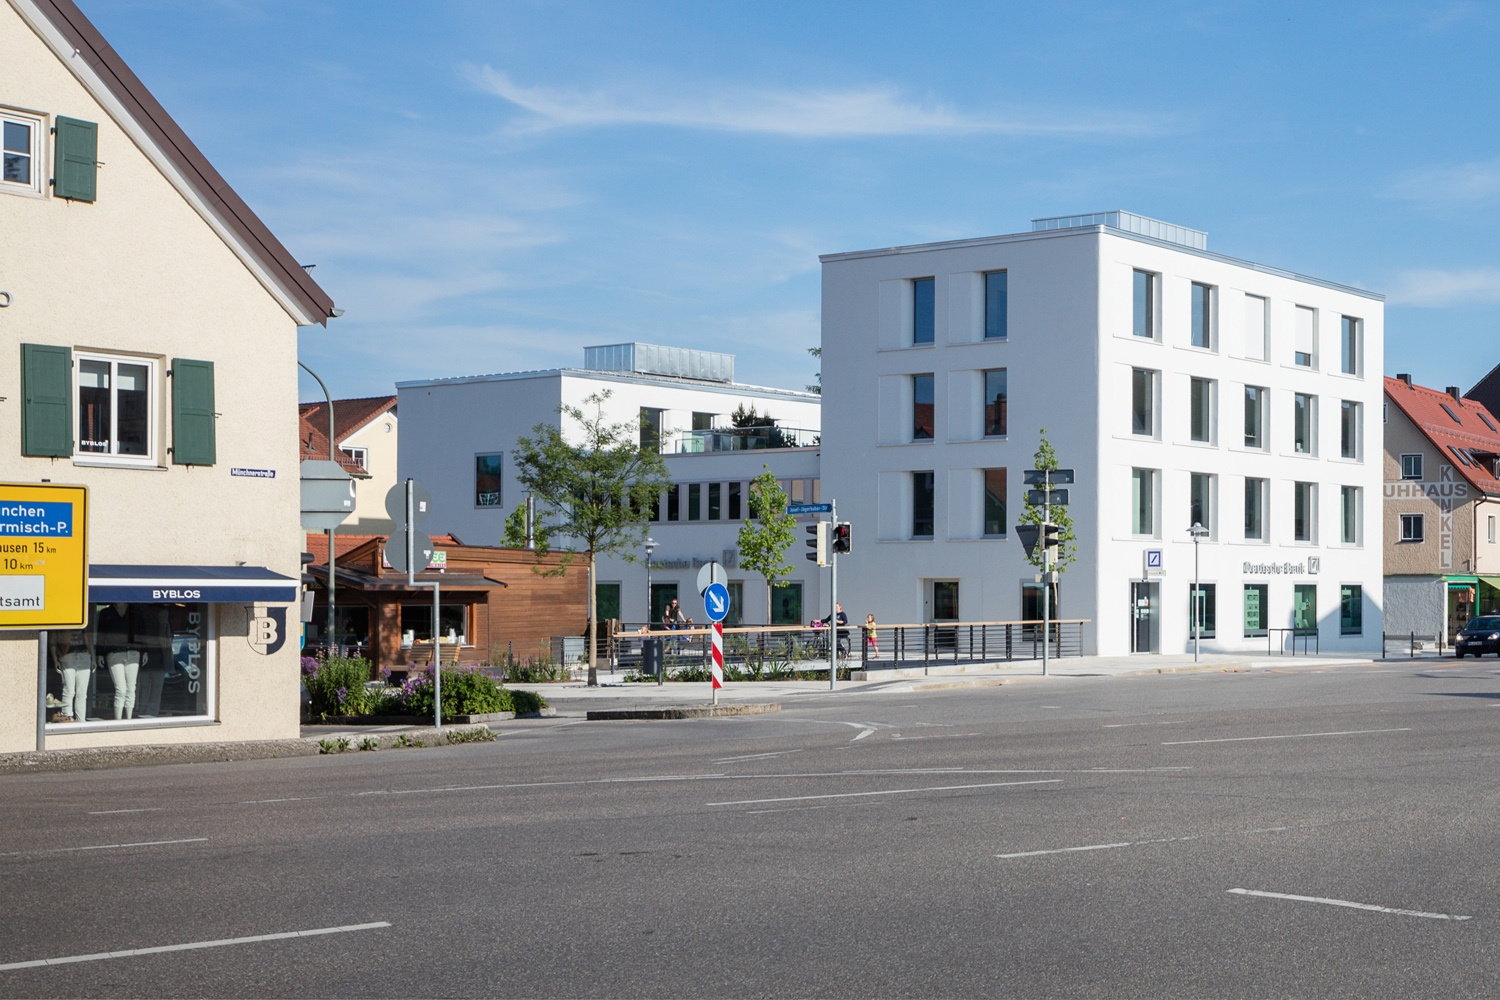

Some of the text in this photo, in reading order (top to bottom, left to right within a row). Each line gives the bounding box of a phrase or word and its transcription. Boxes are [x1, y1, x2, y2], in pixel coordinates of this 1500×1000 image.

[1440, 466, 1453, 567] KUNKEL
[33, 542, 44, 553] 15
[4, 559, 33, 570] 10 km
[1243, 561, 1305, 574] Deutsche Bank
[152, 589, 201, 599] BYBLOS
[188, 612, 201, 694] BYBLOS
